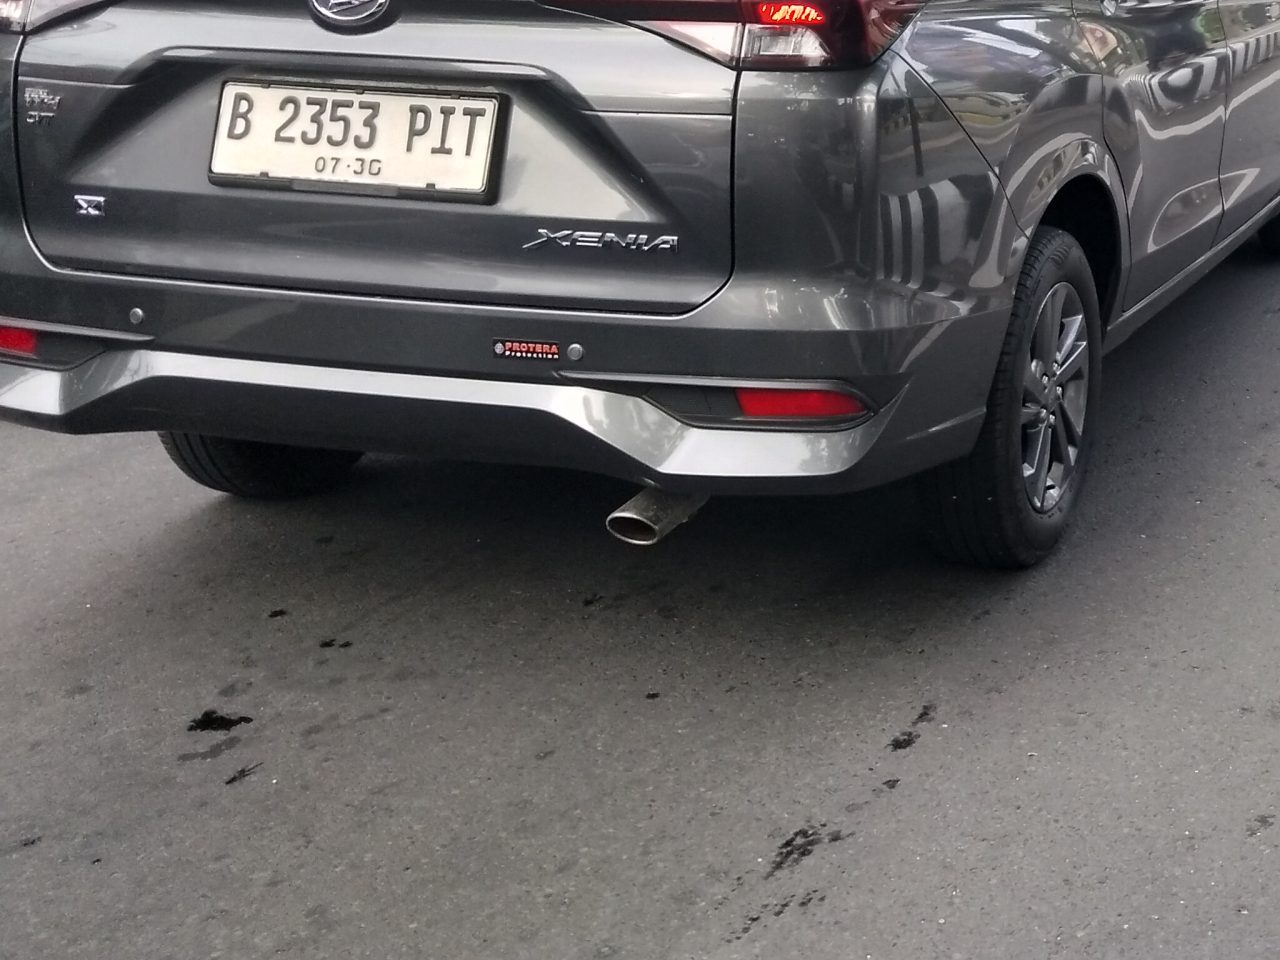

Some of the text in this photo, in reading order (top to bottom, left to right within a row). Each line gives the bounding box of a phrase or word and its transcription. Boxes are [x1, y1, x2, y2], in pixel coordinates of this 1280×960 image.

[227, 92, 486, 156] B 2353 PIT
[522, 228, 678, 252] XENIA
[505, 342, 558, 353] PROTERA
